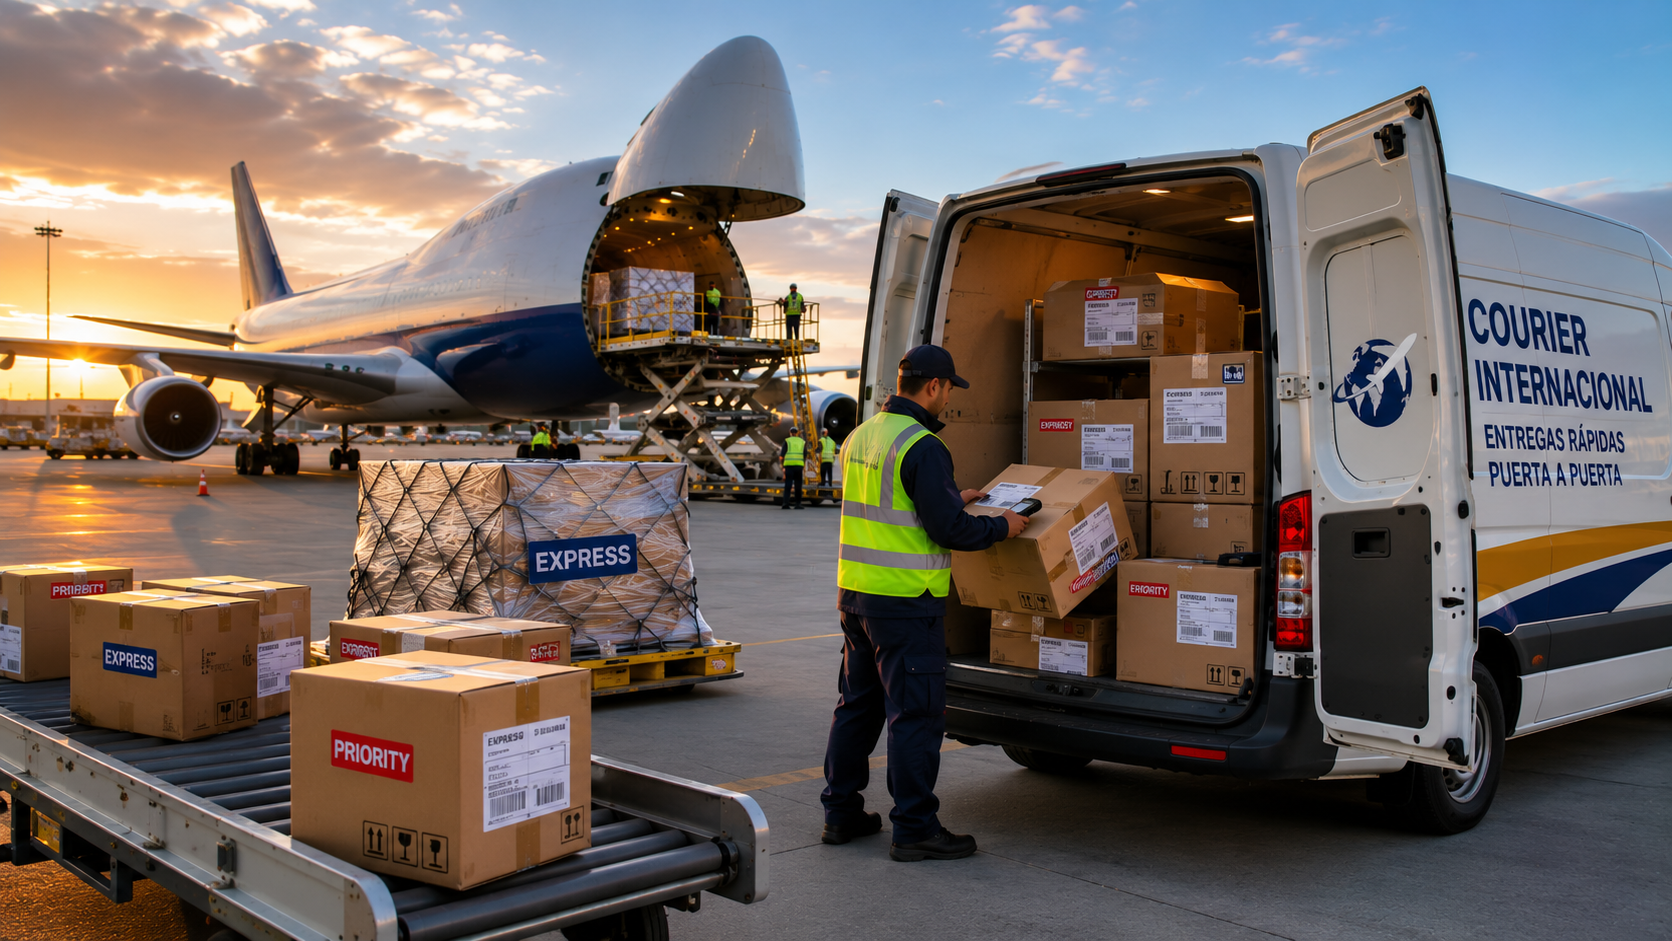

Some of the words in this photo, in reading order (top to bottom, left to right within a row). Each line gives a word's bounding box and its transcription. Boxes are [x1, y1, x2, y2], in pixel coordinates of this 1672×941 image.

[1468, 298, 1591, 357] COURIER
[1474, 359, 1653, 413] INTERNACIONAL
[1483, 424, 1565, 452] ENTREGAS
[1568, 423, 1626, 453] RÁPIDAS
[1488, 461, 1552, 487] PUERTA
[1556, 462, 1567, 487] A
[1569, 462, 1623, 487] PUERTA
[535, 544, 632, 573] EXPRESS
[105, 649, 155, 671] EXPRESS
[334, 738, 411, 773] PRIORITY
